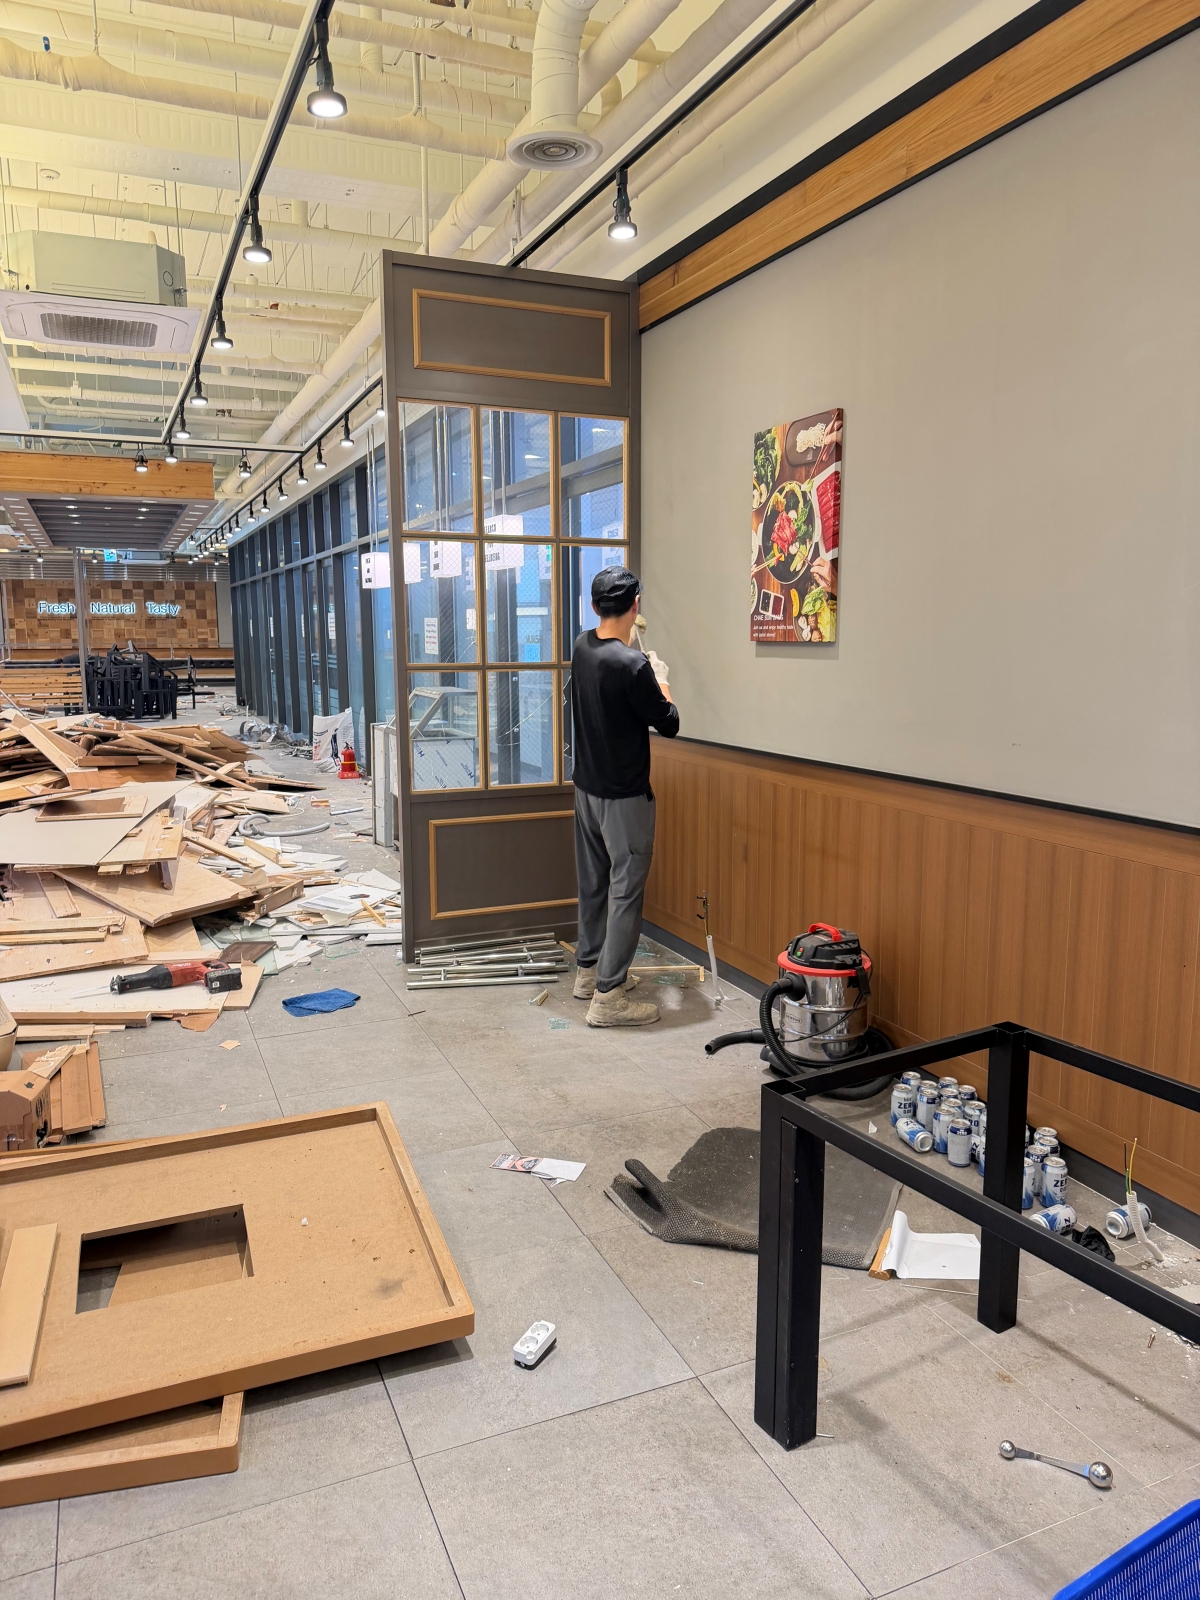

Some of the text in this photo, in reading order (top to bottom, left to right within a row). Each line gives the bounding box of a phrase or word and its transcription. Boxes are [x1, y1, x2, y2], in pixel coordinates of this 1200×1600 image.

[38, 602, 180, 615] Fresh Natural Tasty
[897, 1101, 912, 1109] ZER
